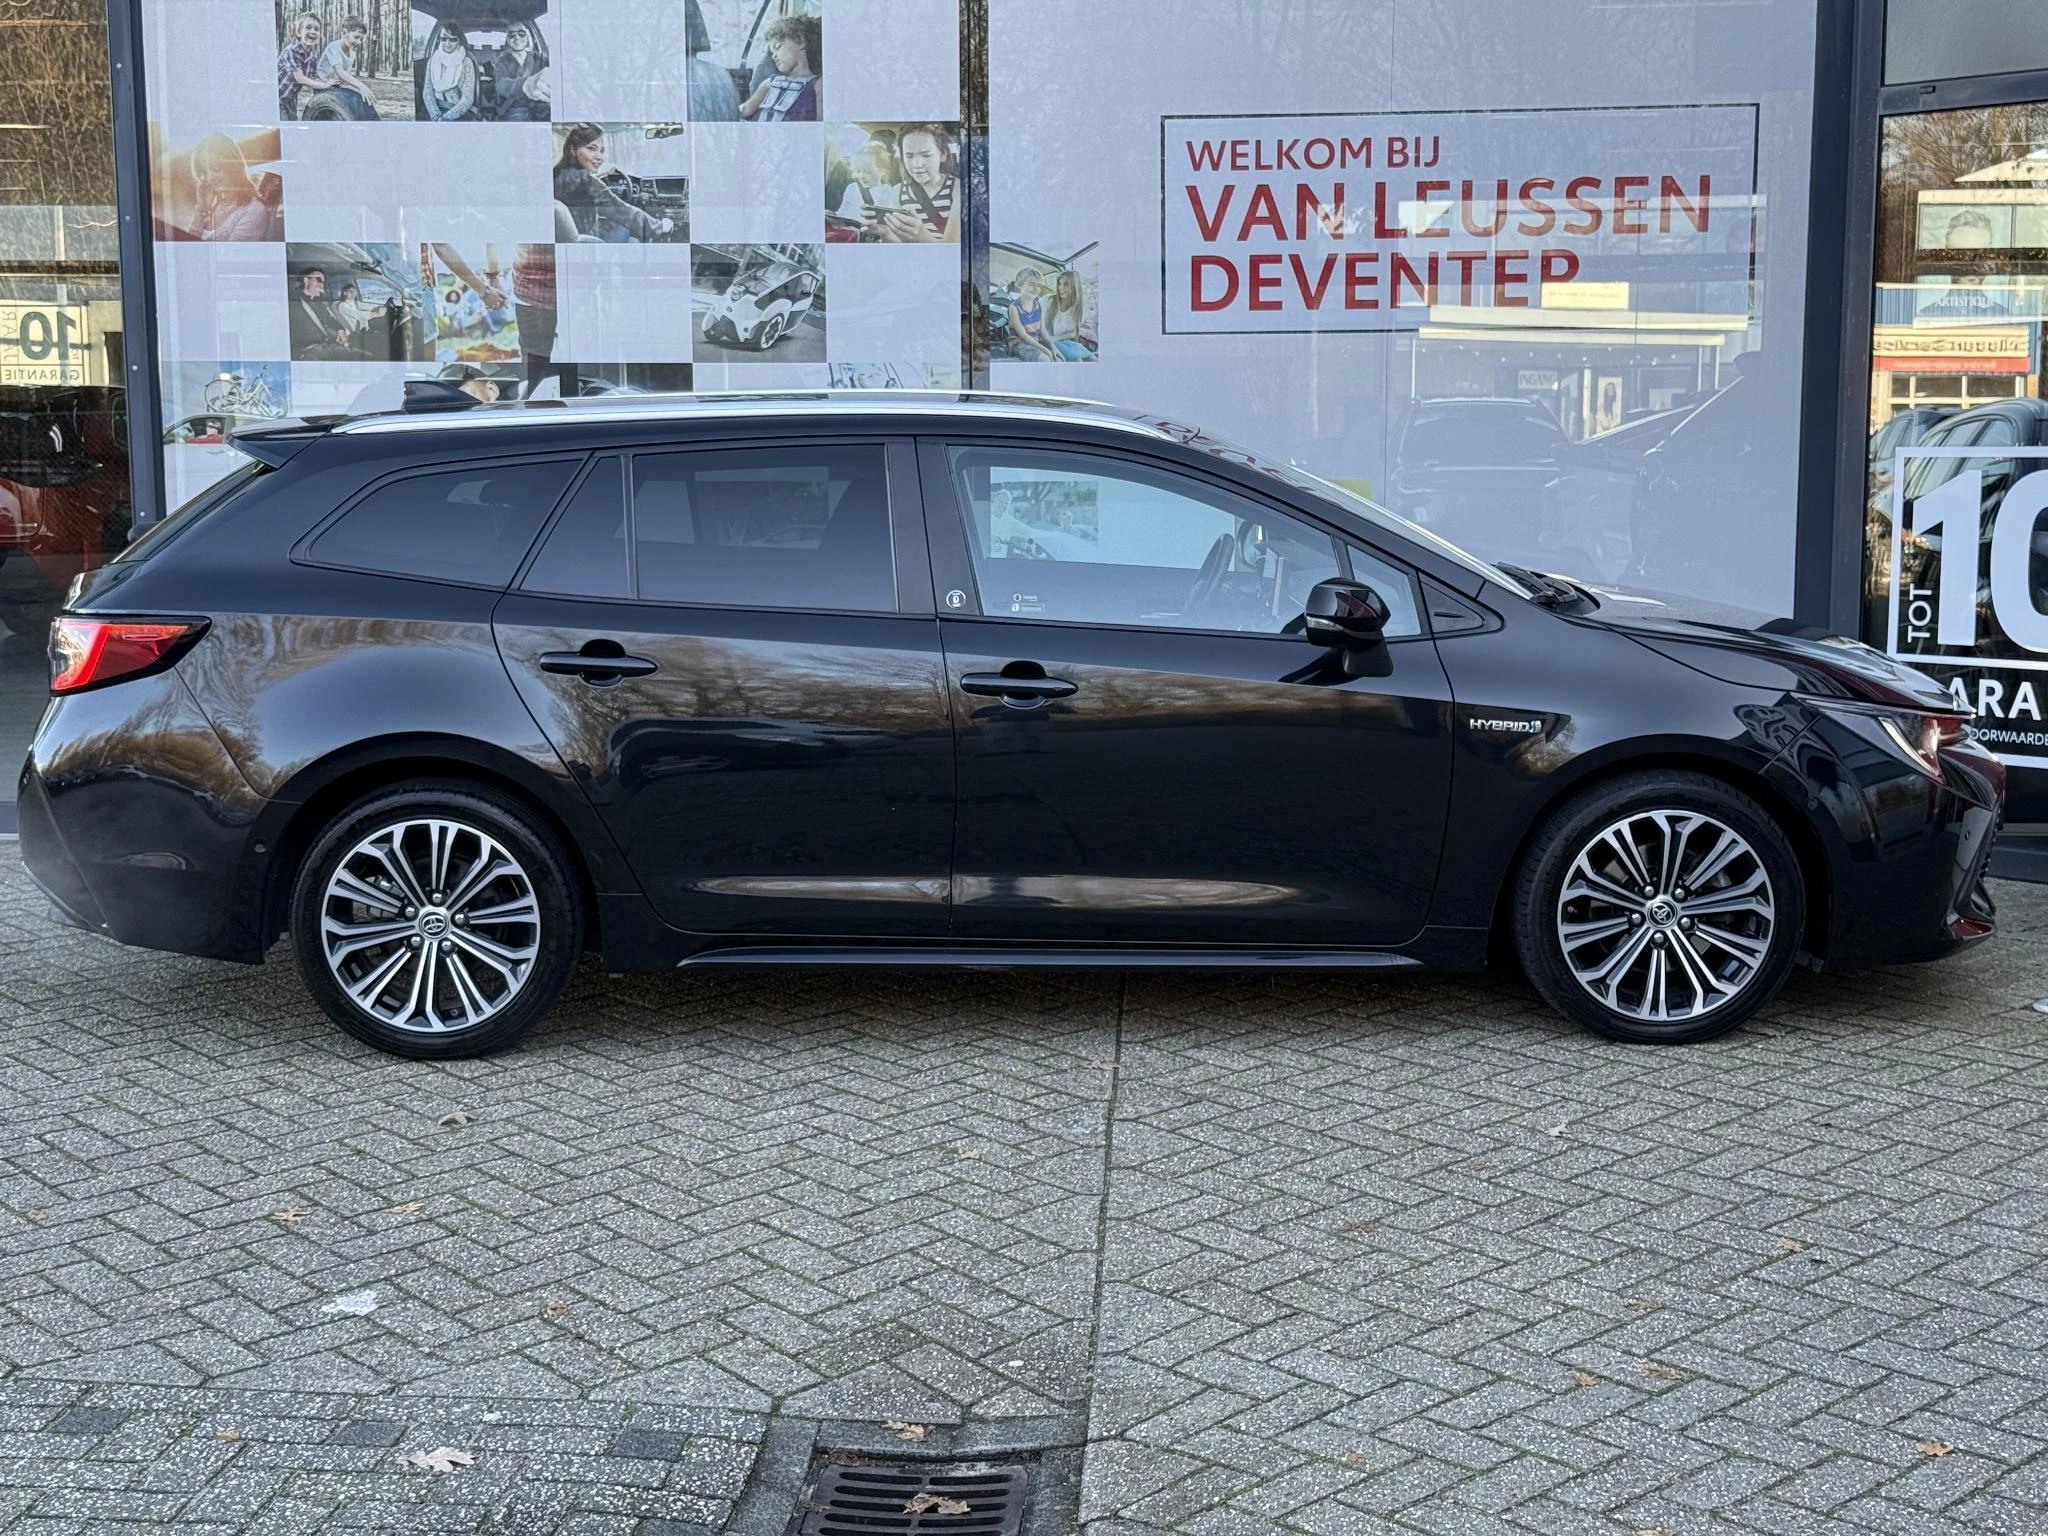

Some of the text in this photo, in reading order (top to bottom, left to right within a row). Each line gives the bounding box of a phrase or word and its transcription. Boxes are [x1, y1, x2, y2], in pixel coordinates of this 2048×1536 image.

[1186, 135, 1440, 171] WELKOM BIJ
[1185, 174, 1711, 242] VAN LEUSSEN
[1908, 582, 1933, 643] TOT
[1469, 718, 1530, 732] HYBRID
